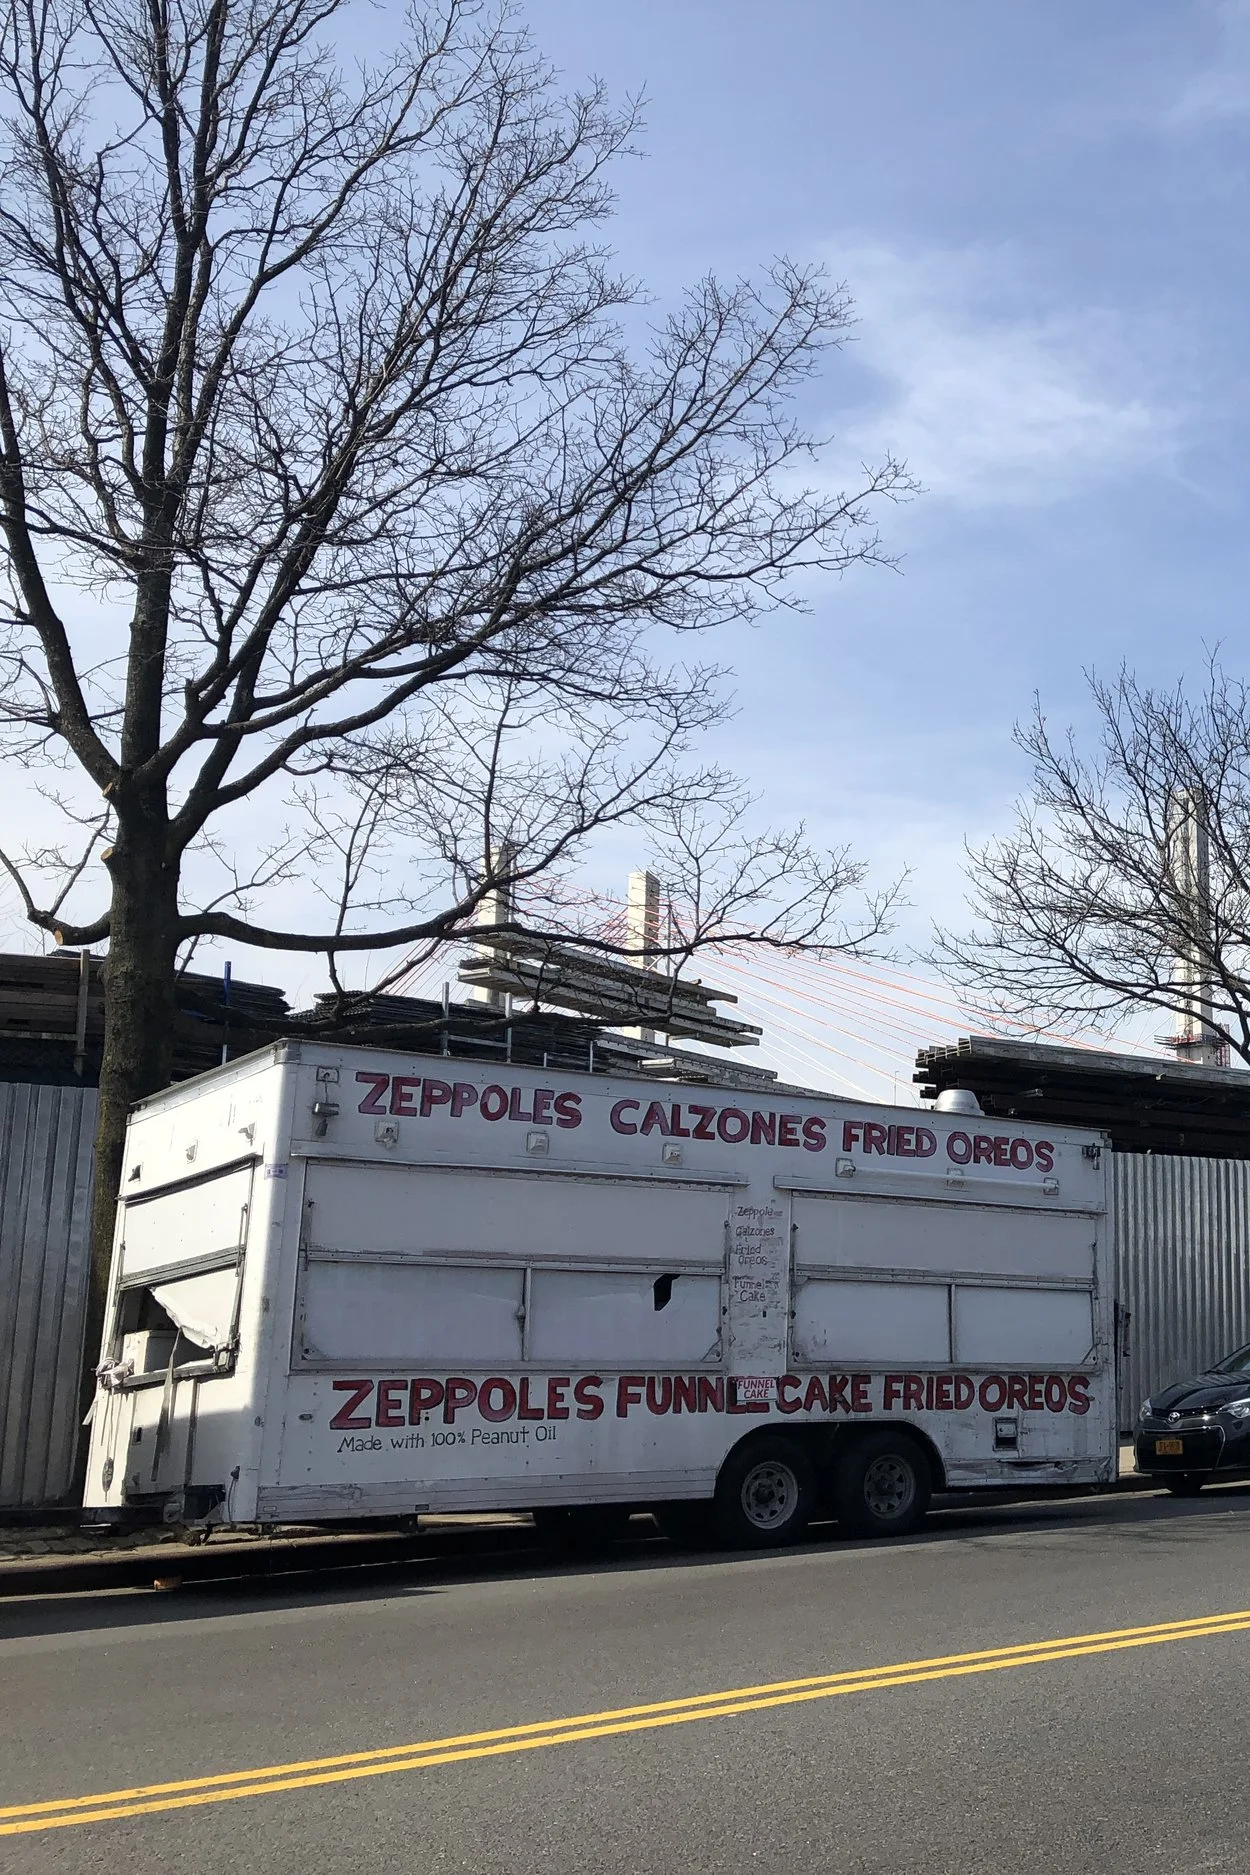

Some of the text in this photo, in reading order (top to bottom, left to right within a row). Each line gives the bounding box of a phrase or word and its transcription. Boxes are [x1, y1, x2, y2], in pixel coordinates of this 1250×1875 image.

[355, 1071, 1055, 1173] ZEPPOLES CALZONES FRIED OREOS
[738, 1379, 775, 1390] FUNNEL
[743, 1389, 769, 1399] CAKE
[329, 1376, 605, 1430] ZEPPOLES
[776, 1375, 873, 1414] CAKE
[883, 1375, 976, 1411] FRIED
[978, 1375, 1091, 1415] OREOS
[337, 1425, 557, 1453] Made with 100% Peanut Oil
